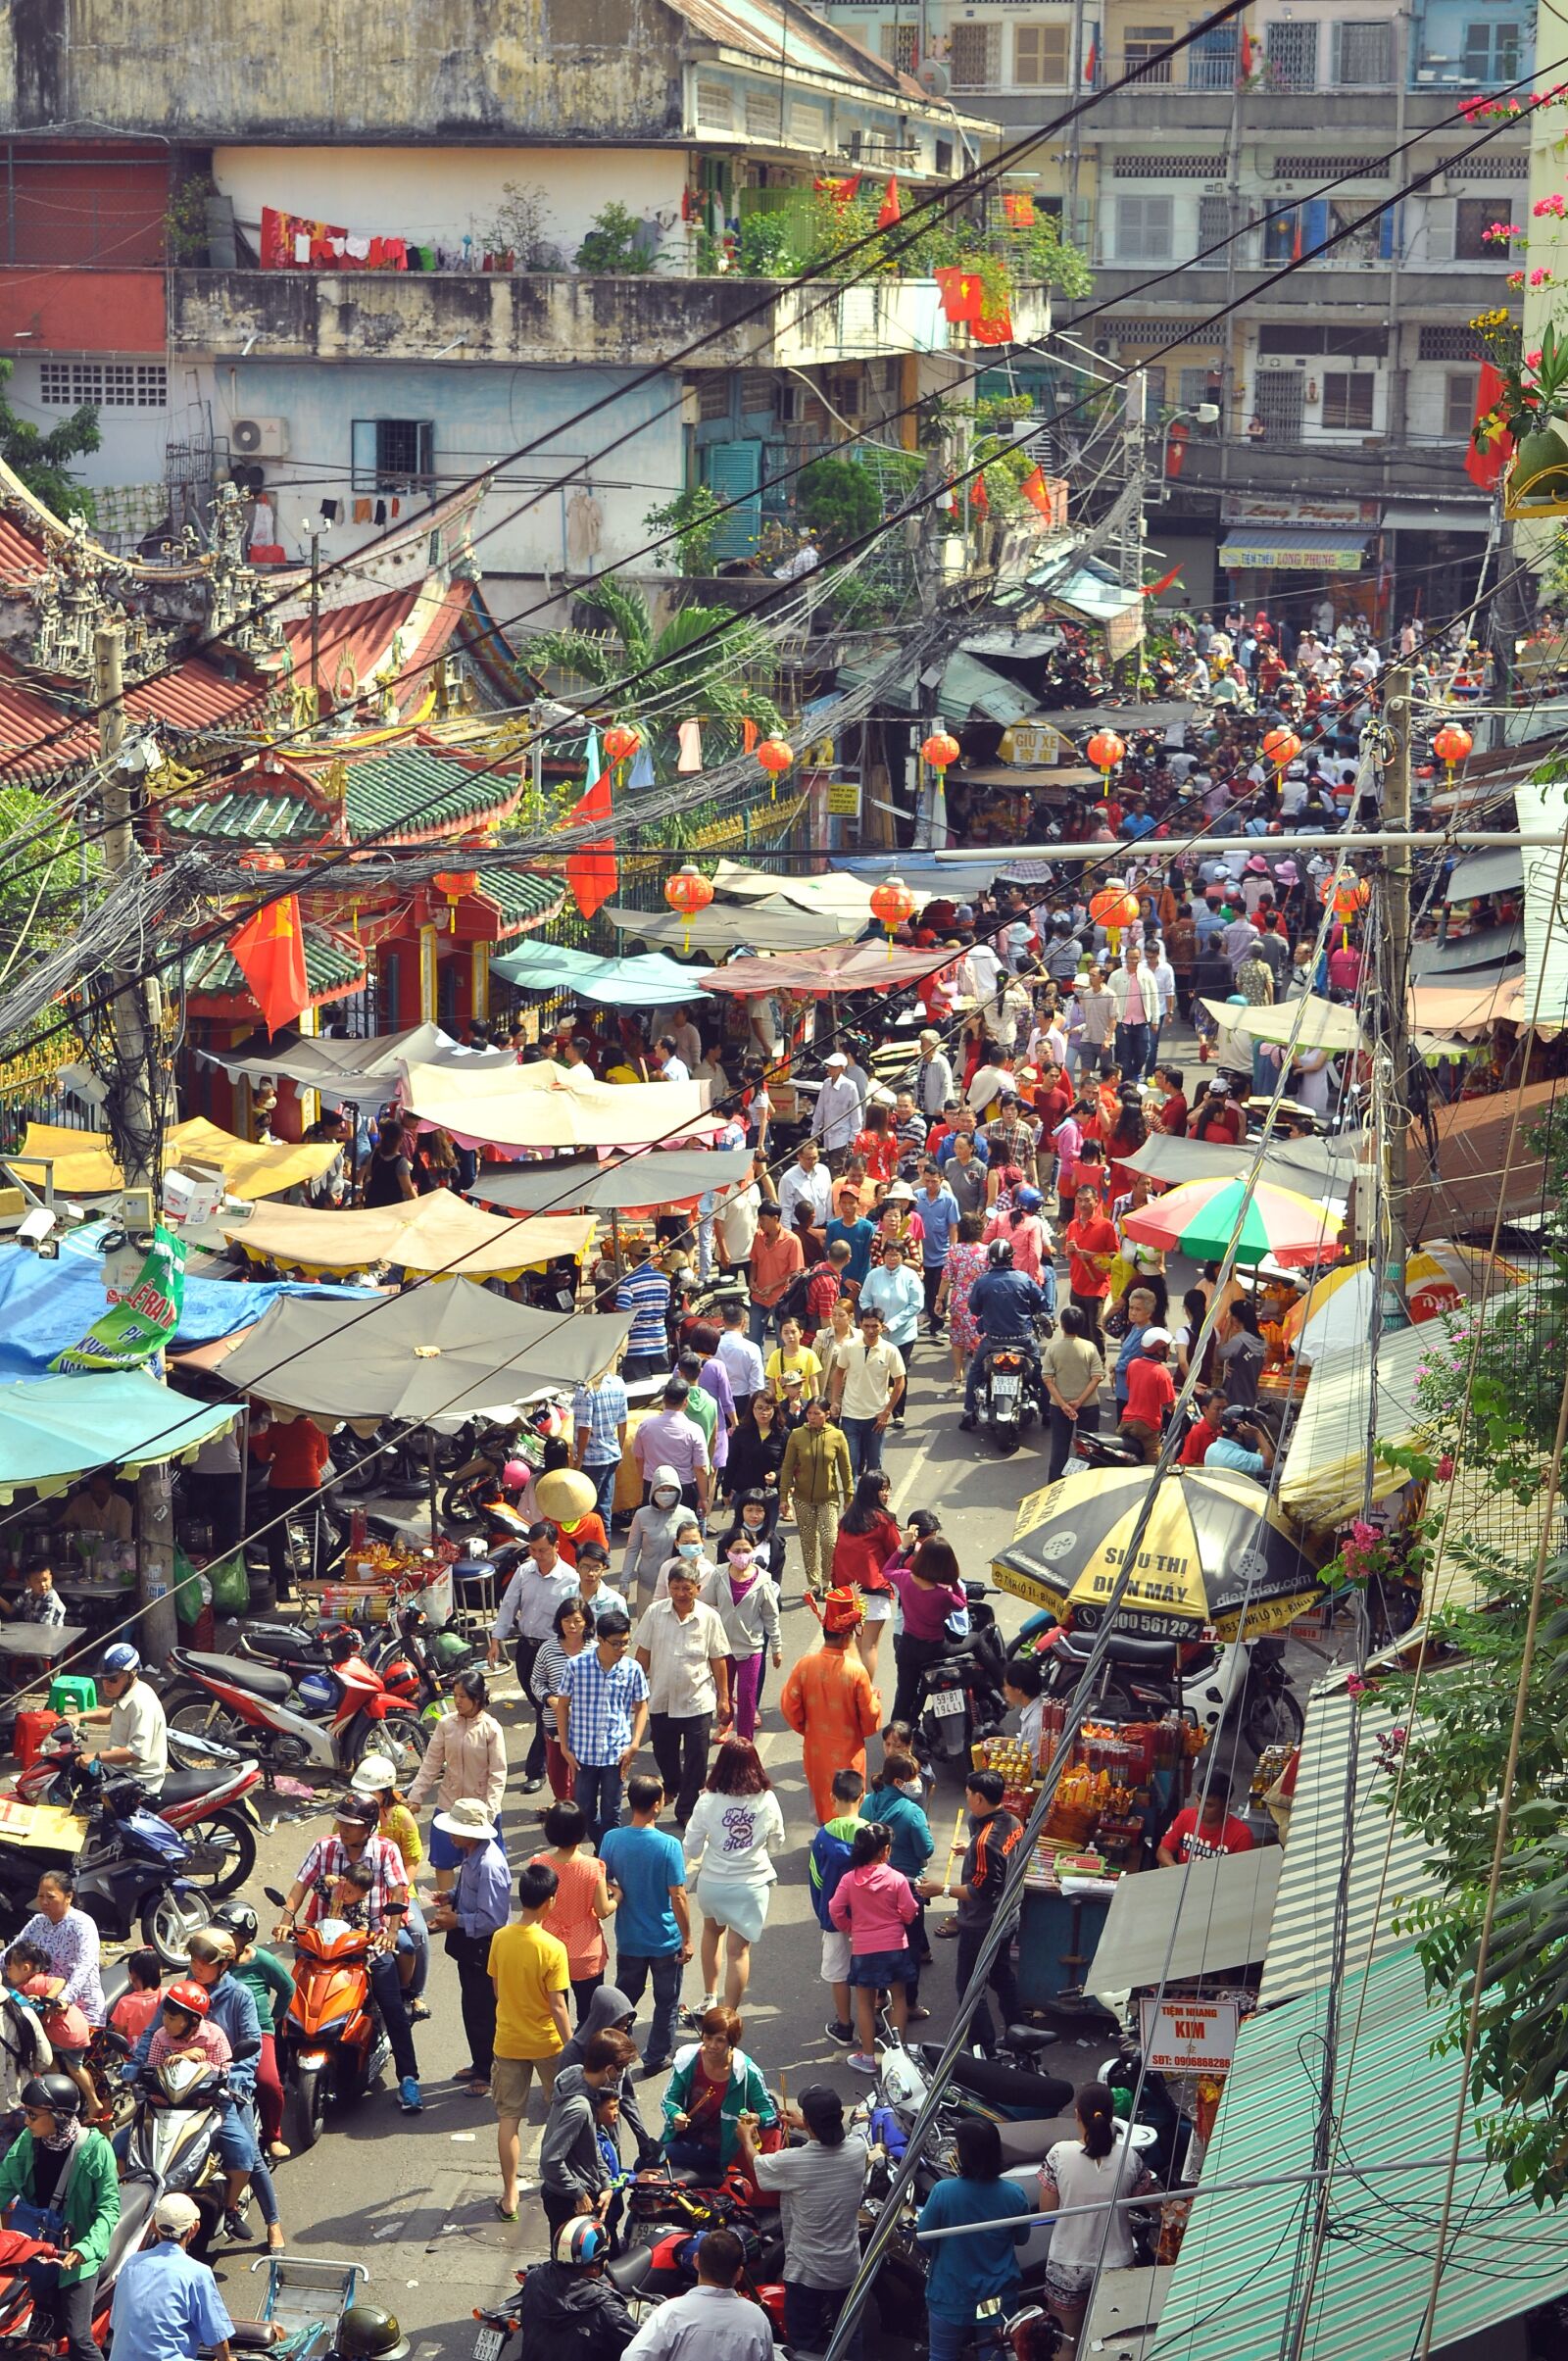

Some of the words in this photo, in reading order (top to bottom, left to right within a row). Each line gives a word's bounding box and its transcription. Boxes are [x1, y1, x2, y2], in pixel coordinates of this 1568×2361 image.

[1042, 735, 1057, 750] XE
[1104, 1548, 1152, 1568] SIU
[1156, 1554, 1188, 1578] THỊ
[1093, 1575, 1140, 1598] ĐIN
[1145, 1581, 1190, 1603] MÁY
[1216, 1573, 1311, 1606] dienmay.com
[1140, 1614, 1168, 1635] 561
[1161, 2005, 1184, 2018] TIỆM
[1186, 2006, 1217, 2019] NHANG
[1175, 2020, 1205, 2040] KIM
